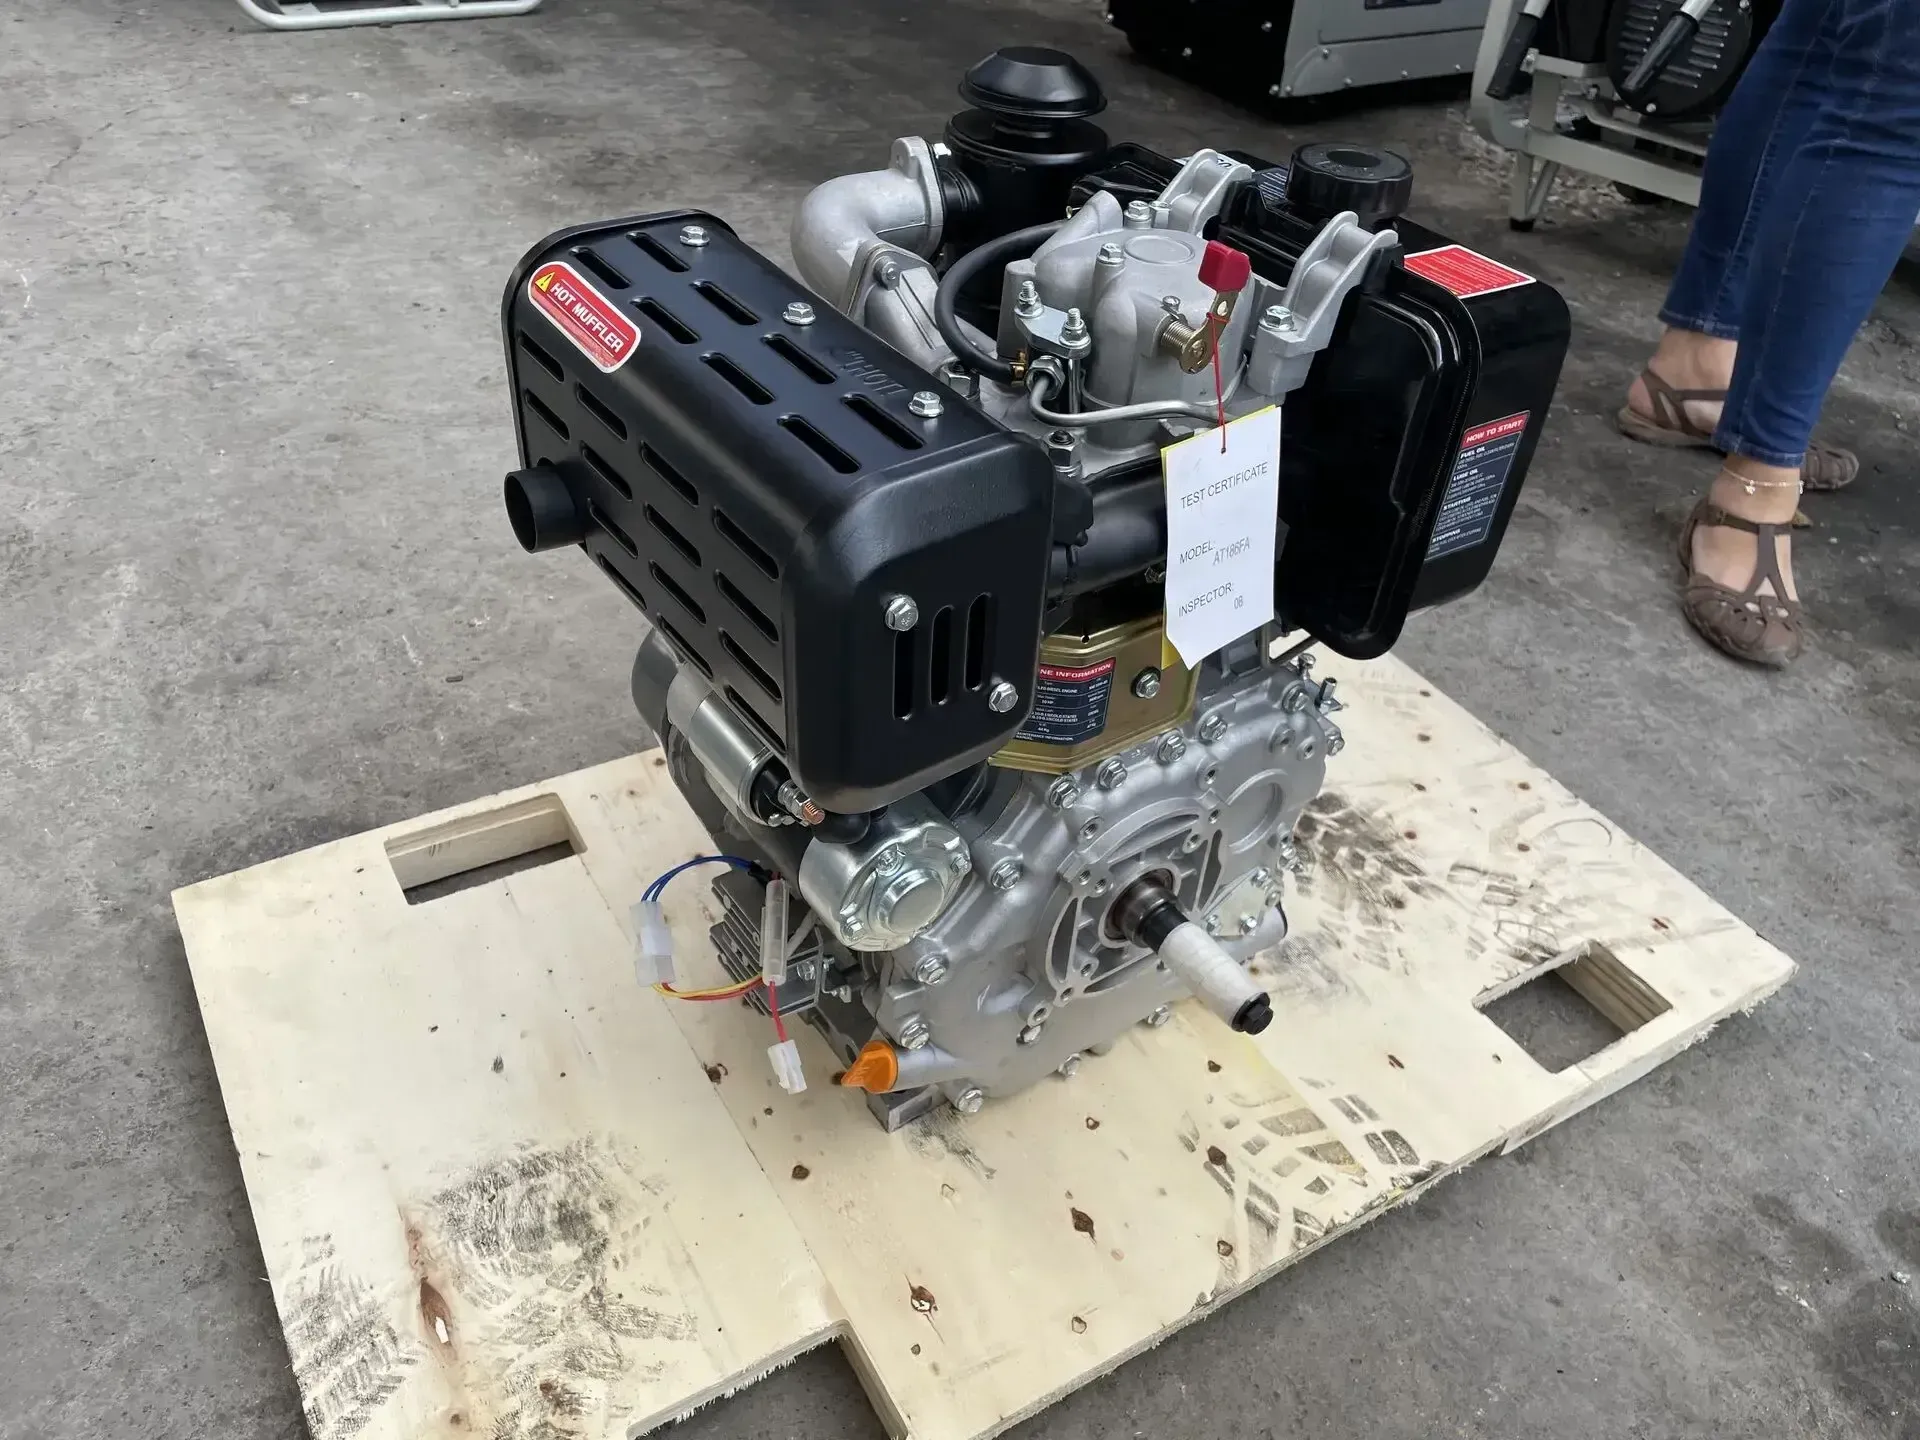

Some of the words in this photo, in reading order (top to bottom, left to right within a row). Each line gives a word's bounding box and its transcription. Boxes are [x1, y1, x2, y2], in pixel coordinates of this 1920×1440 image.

[549, 282, 577, 306] HOT
[571, 303, 625, 353] MUFFLER
[1466, 431, 1485, 443] HOW
[1486, 428, 1497, 437] TO
[1497, 419, 1523, 433] START
[1460, 449, 1476, 459] FUEL
[1180, 488, 1206, 509] TEST
[1207, 461, 1268, 498] CERTIFICATE
[1179, 540, 1216, 565] MODEL:
[1212, 536, 1251, 566] AT186FA
[1178, 582, 1235, 618] INSPECTOR:
[1055, 663, 1111, 678] INFORMATION
